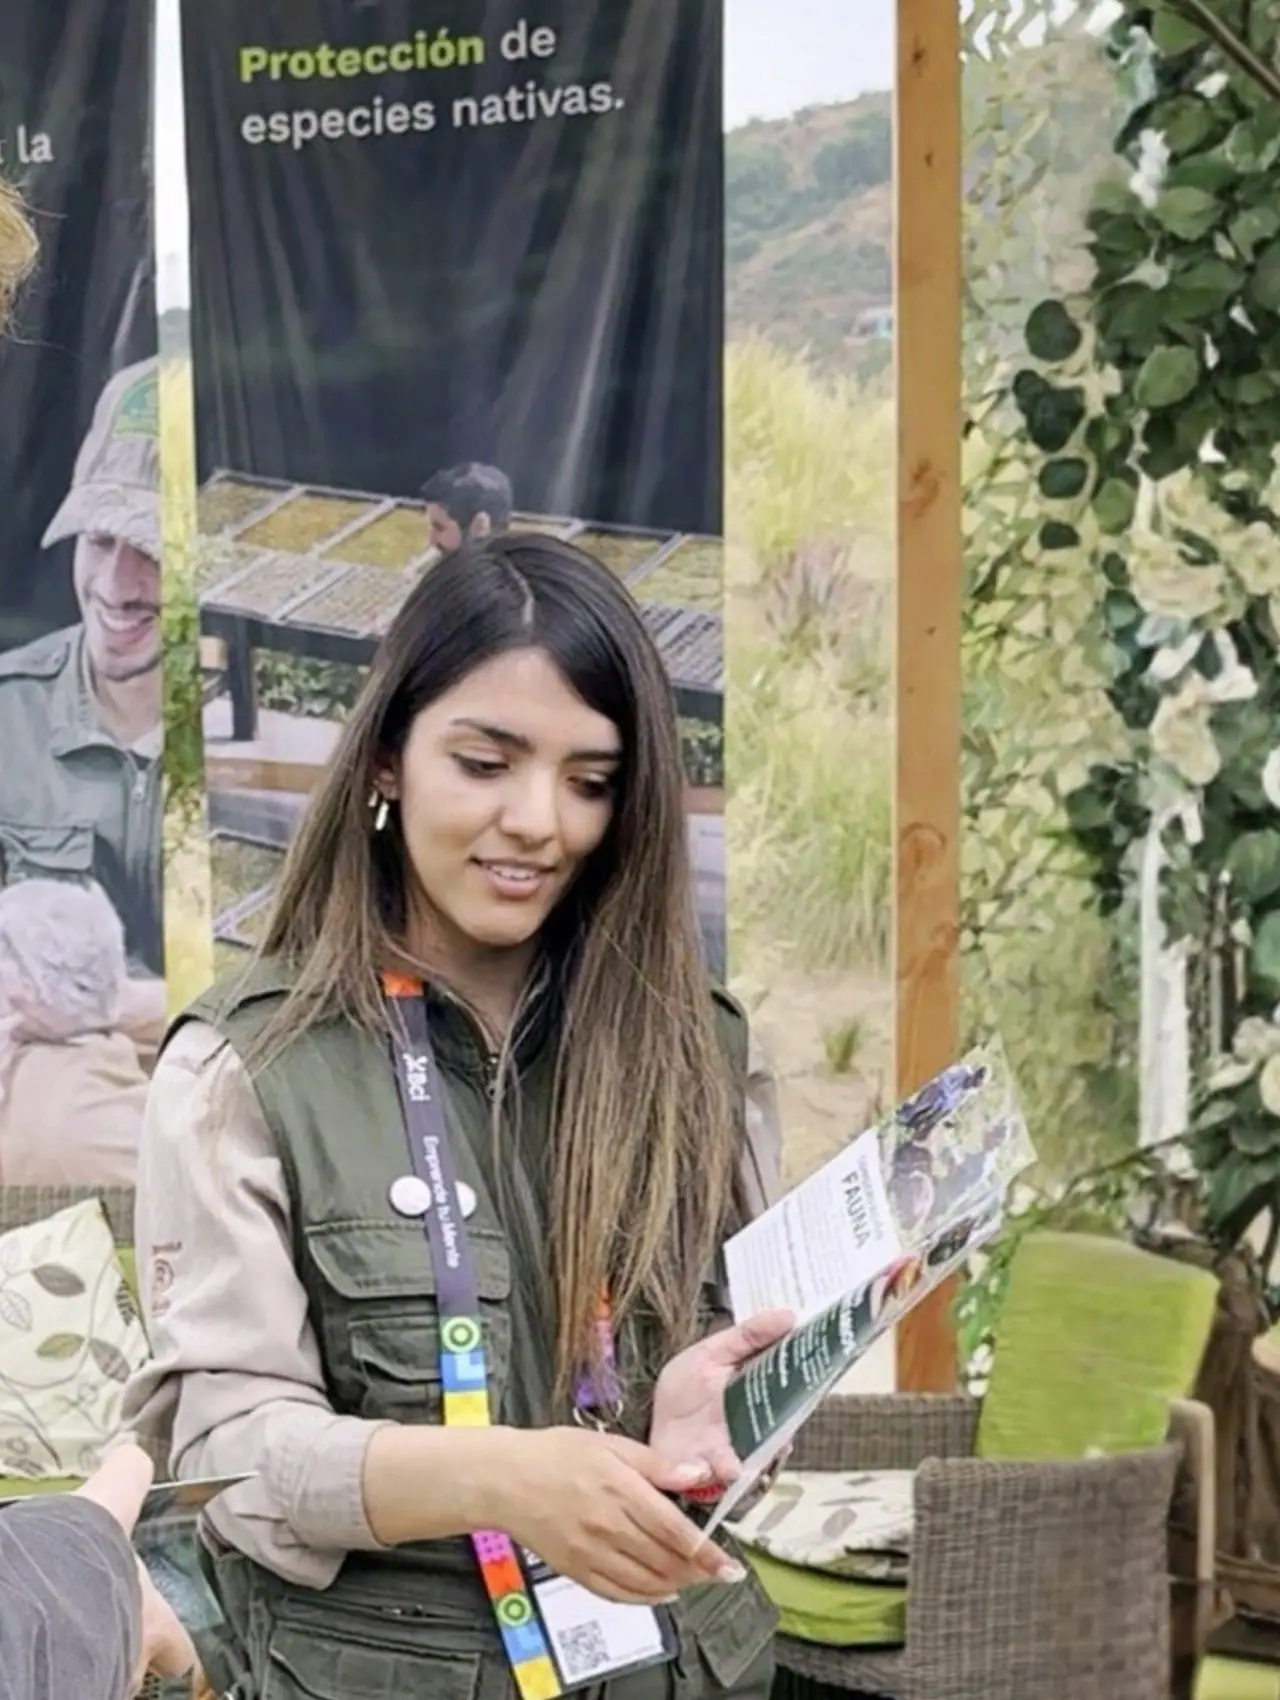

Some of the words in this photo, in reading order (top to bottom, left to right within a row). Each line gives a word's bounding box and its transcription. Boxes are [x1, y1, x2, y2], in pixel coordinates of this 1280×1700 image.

[239, 28, 485, 82] Protección
[500, 19, 558, 61] de
[16, 123, 55, 164] la
[240, 84, 436, 149] especies
[452, 80, 626, 128] nativas.
[841, 1169, 871, 1250] FAUNA
